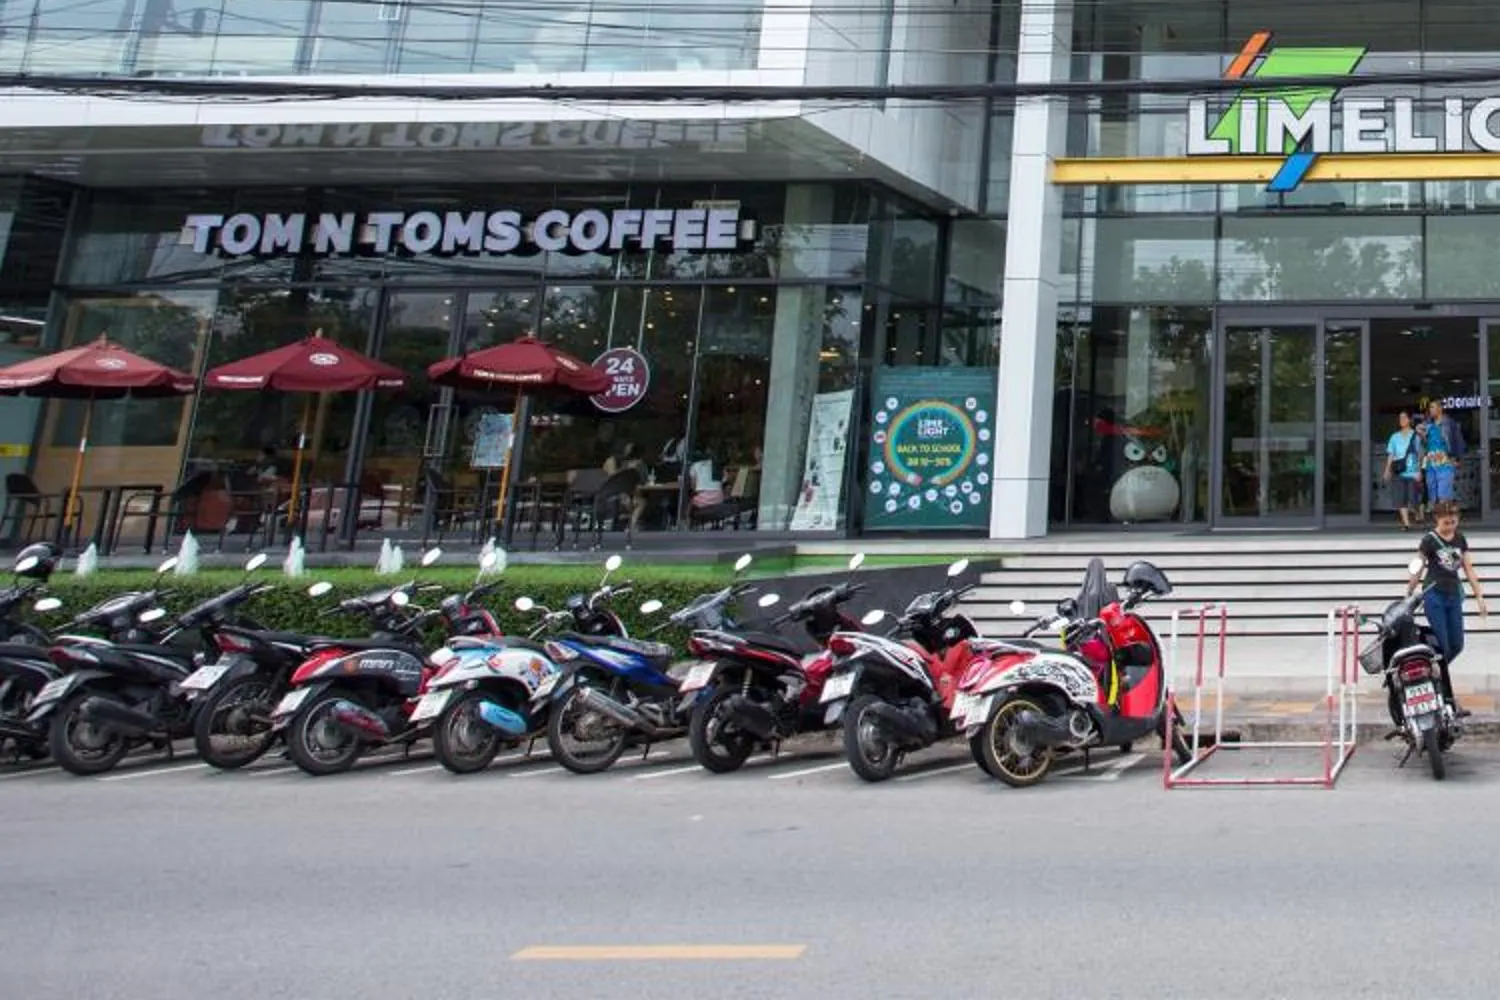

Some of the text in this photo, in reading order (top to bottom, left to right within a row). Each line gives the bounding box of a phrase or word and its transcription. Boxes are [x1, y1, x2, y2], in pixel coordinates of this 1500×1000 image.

[186, 208, 740, 254] TOM N TOMS COFFEE
[606, 357, 636, 375] 24
[605, 383, 641, 397] EN
